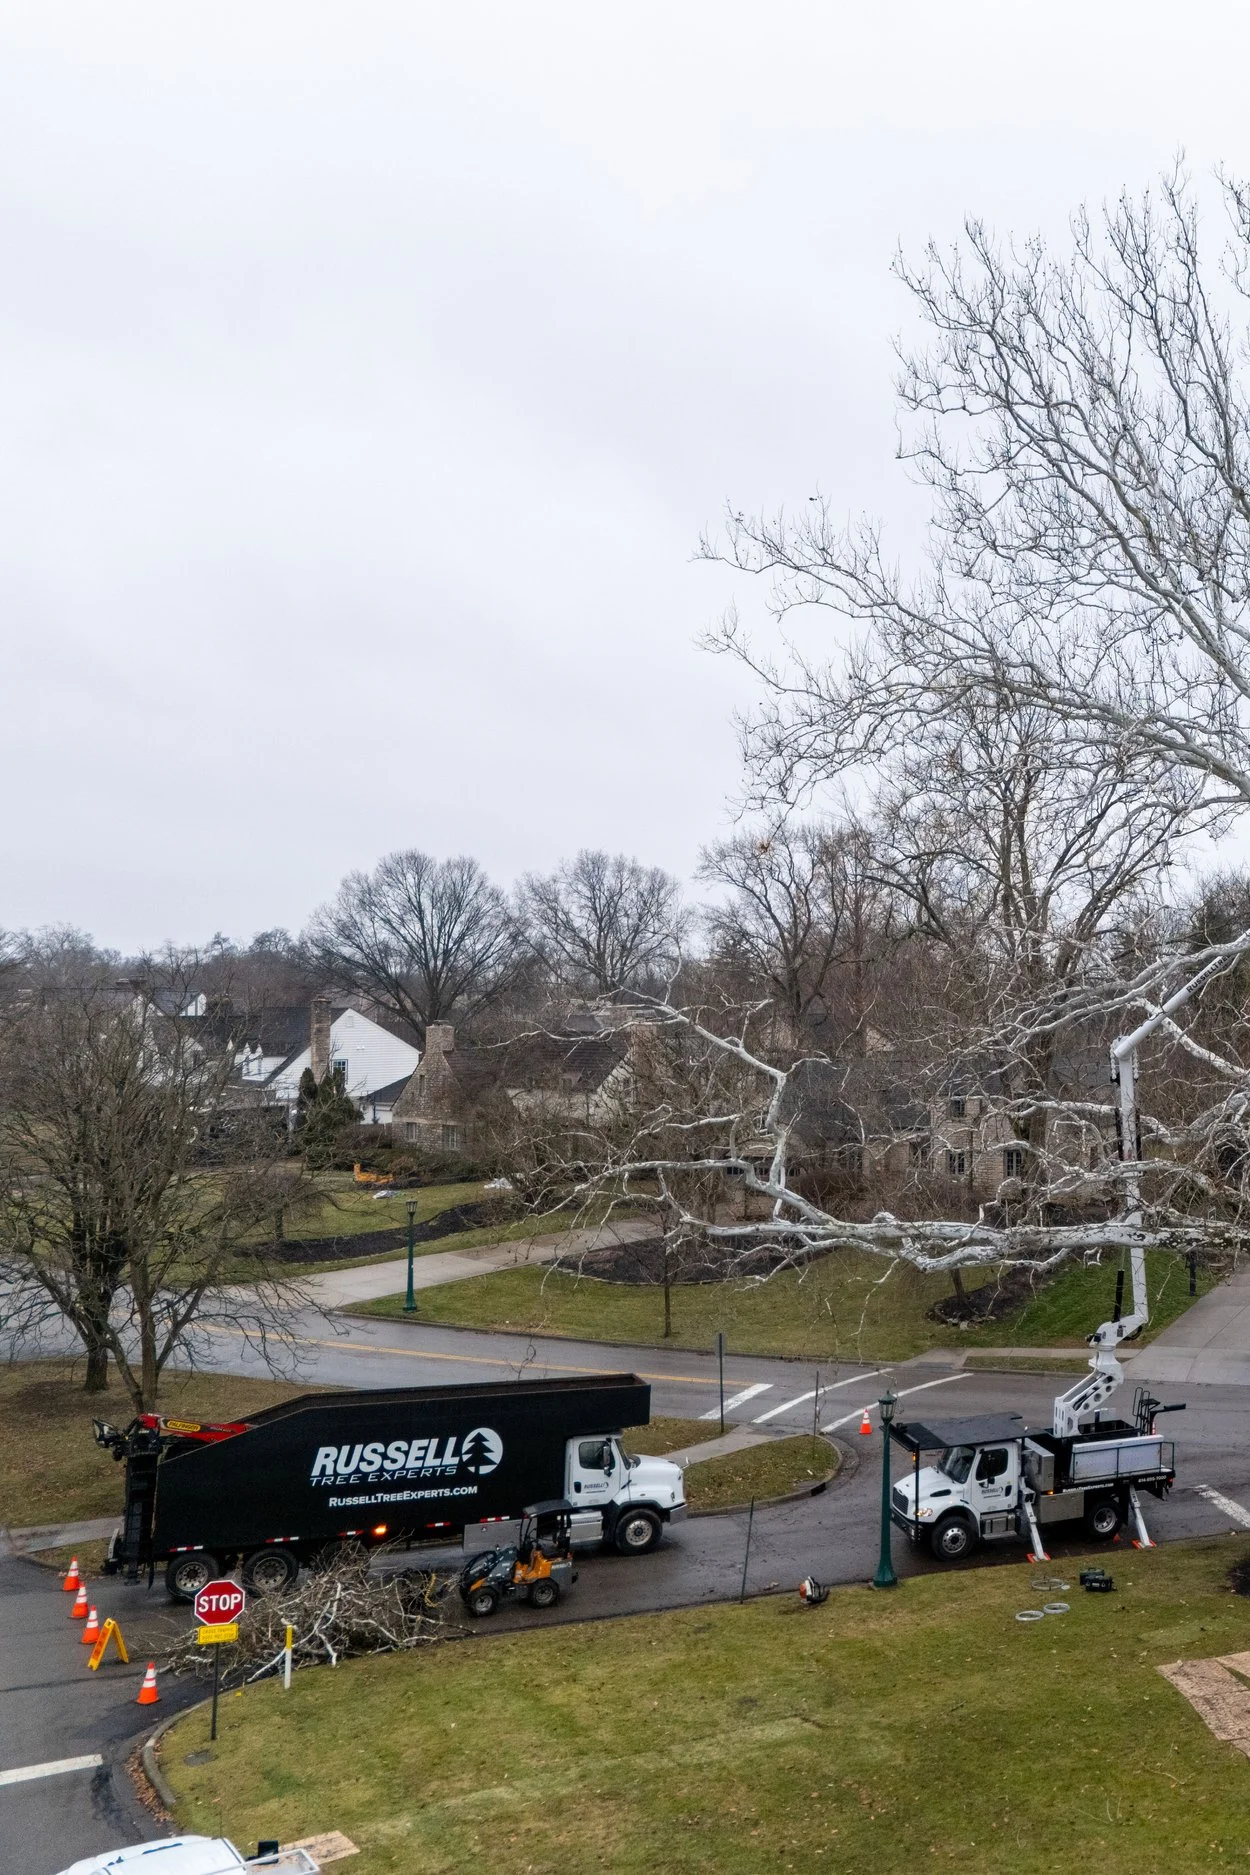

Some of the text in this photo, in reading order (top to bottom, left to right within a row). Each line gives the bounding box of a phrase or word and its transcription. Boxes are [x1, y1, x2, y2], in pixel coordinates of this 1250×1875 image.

[310, 1436, 461, 1476] RUSSELL
[309, 1465, 458, 1487] TREE EXPERTS
[199, 1593, 241, 1612] STOP
